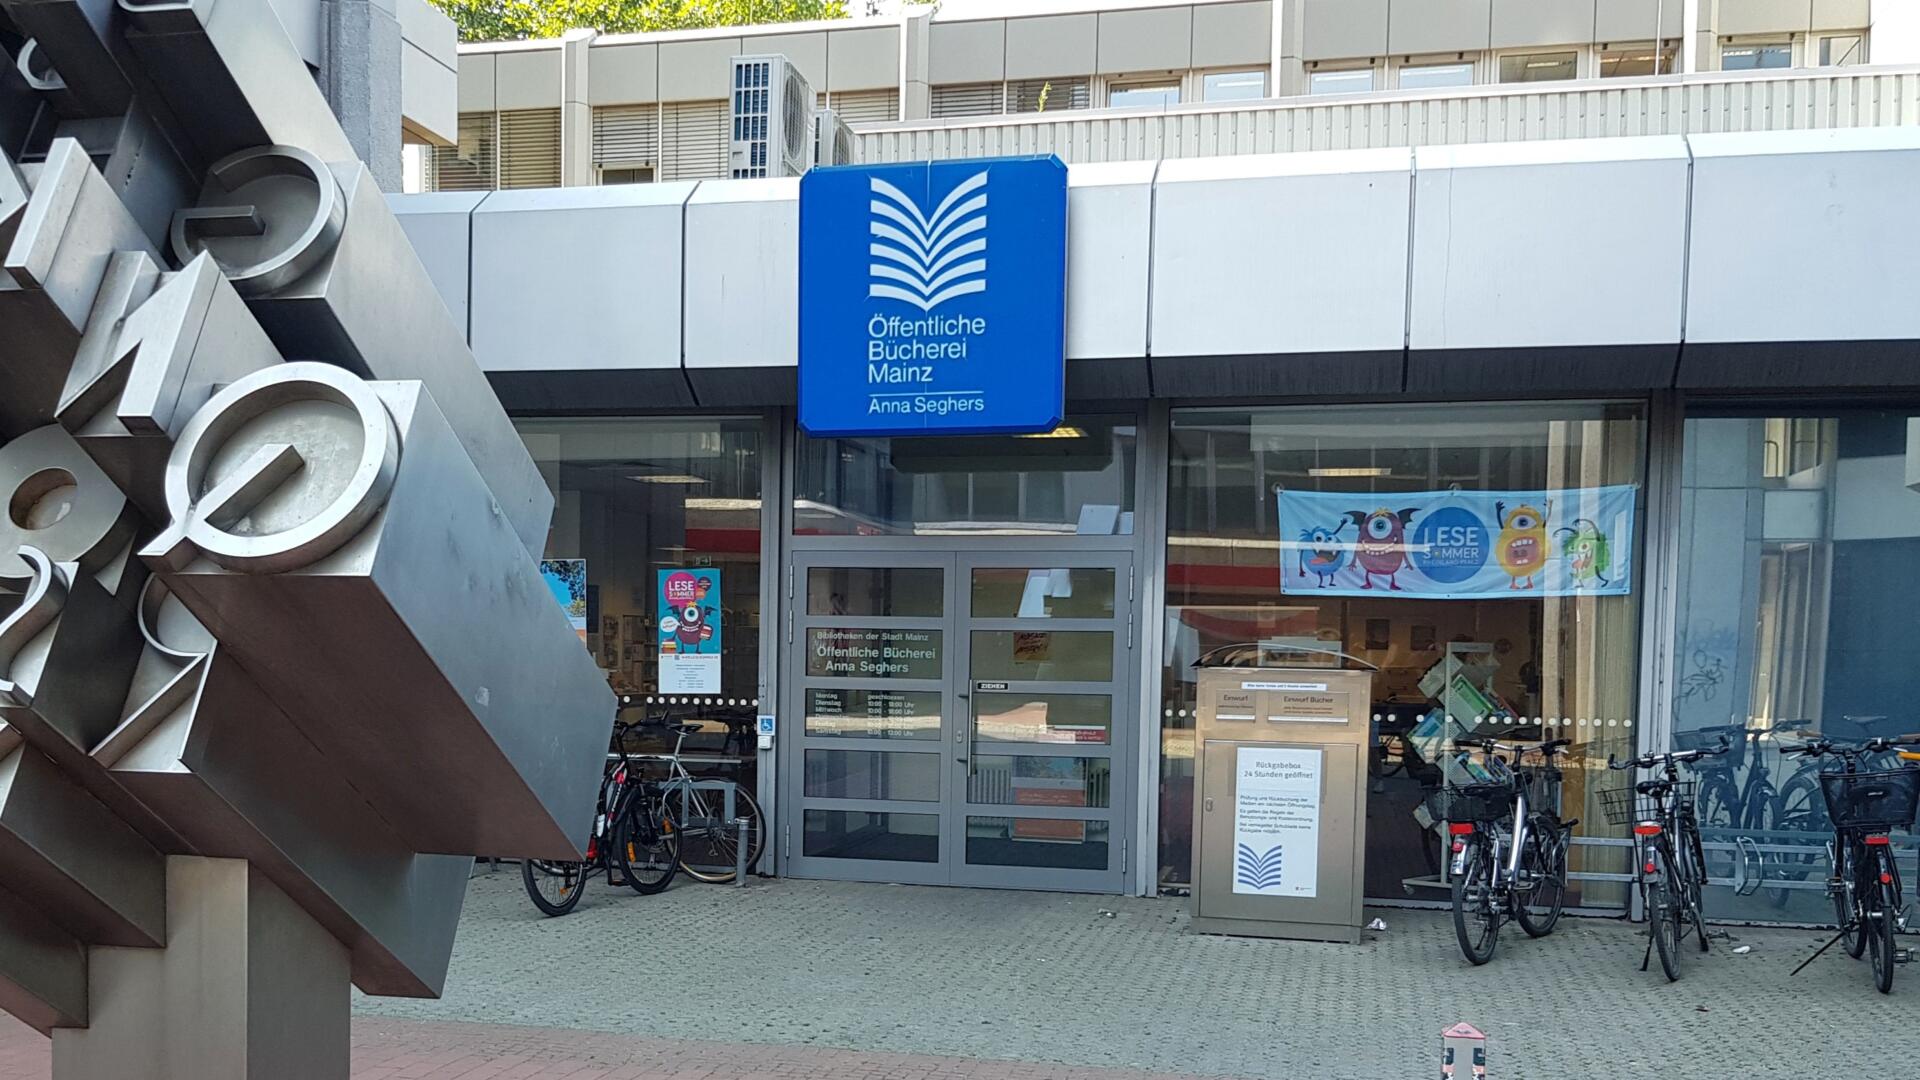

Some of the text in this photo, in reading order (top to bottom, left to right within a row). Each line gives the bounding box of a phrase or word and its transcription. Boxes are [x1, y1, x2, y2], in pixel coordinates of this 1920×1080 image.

[868, 312, 986, 338] Öffentliche
[868, 337, 967, 361] Bücherei
[868, 362, 934, 384] Mainz
[868, 396, 985, 416] Anna Seghers
[1423, 526, 1479, 547] LESE
[668, 580, 695, 591] LESE
[817, 631, 929, 641] Bibliotheken der Stadt Mainz
[817, 643, 936, 659] Öffentliche Bücherei
[825, 660, 856, 671] Anna
[860, 660, 909, 675] Seghers
[1254, 770, 1283, 778] Stunden
[1284, 771, 1313, 779] geöffnet
